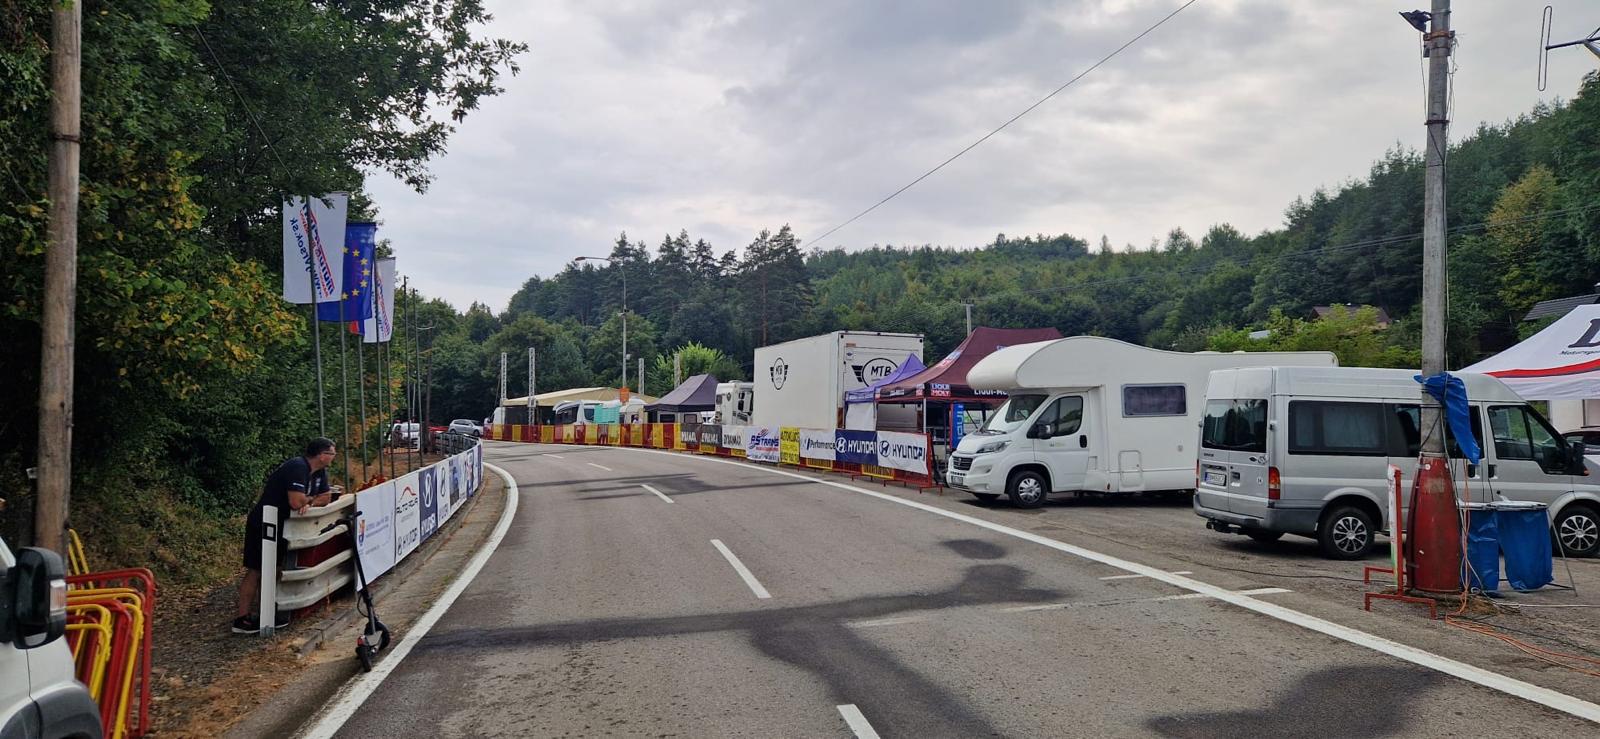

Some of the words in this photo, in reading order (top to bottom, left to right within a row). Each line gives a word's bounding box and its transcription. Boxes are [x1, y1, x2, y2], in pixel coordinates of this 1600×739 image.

[870, 366, 892, 377] MTB
[810, 440, 836, 450] Performance
[848, 440, 877, 454] HYUNDAI
[893, 444, 926, 461] HYUNDAI
